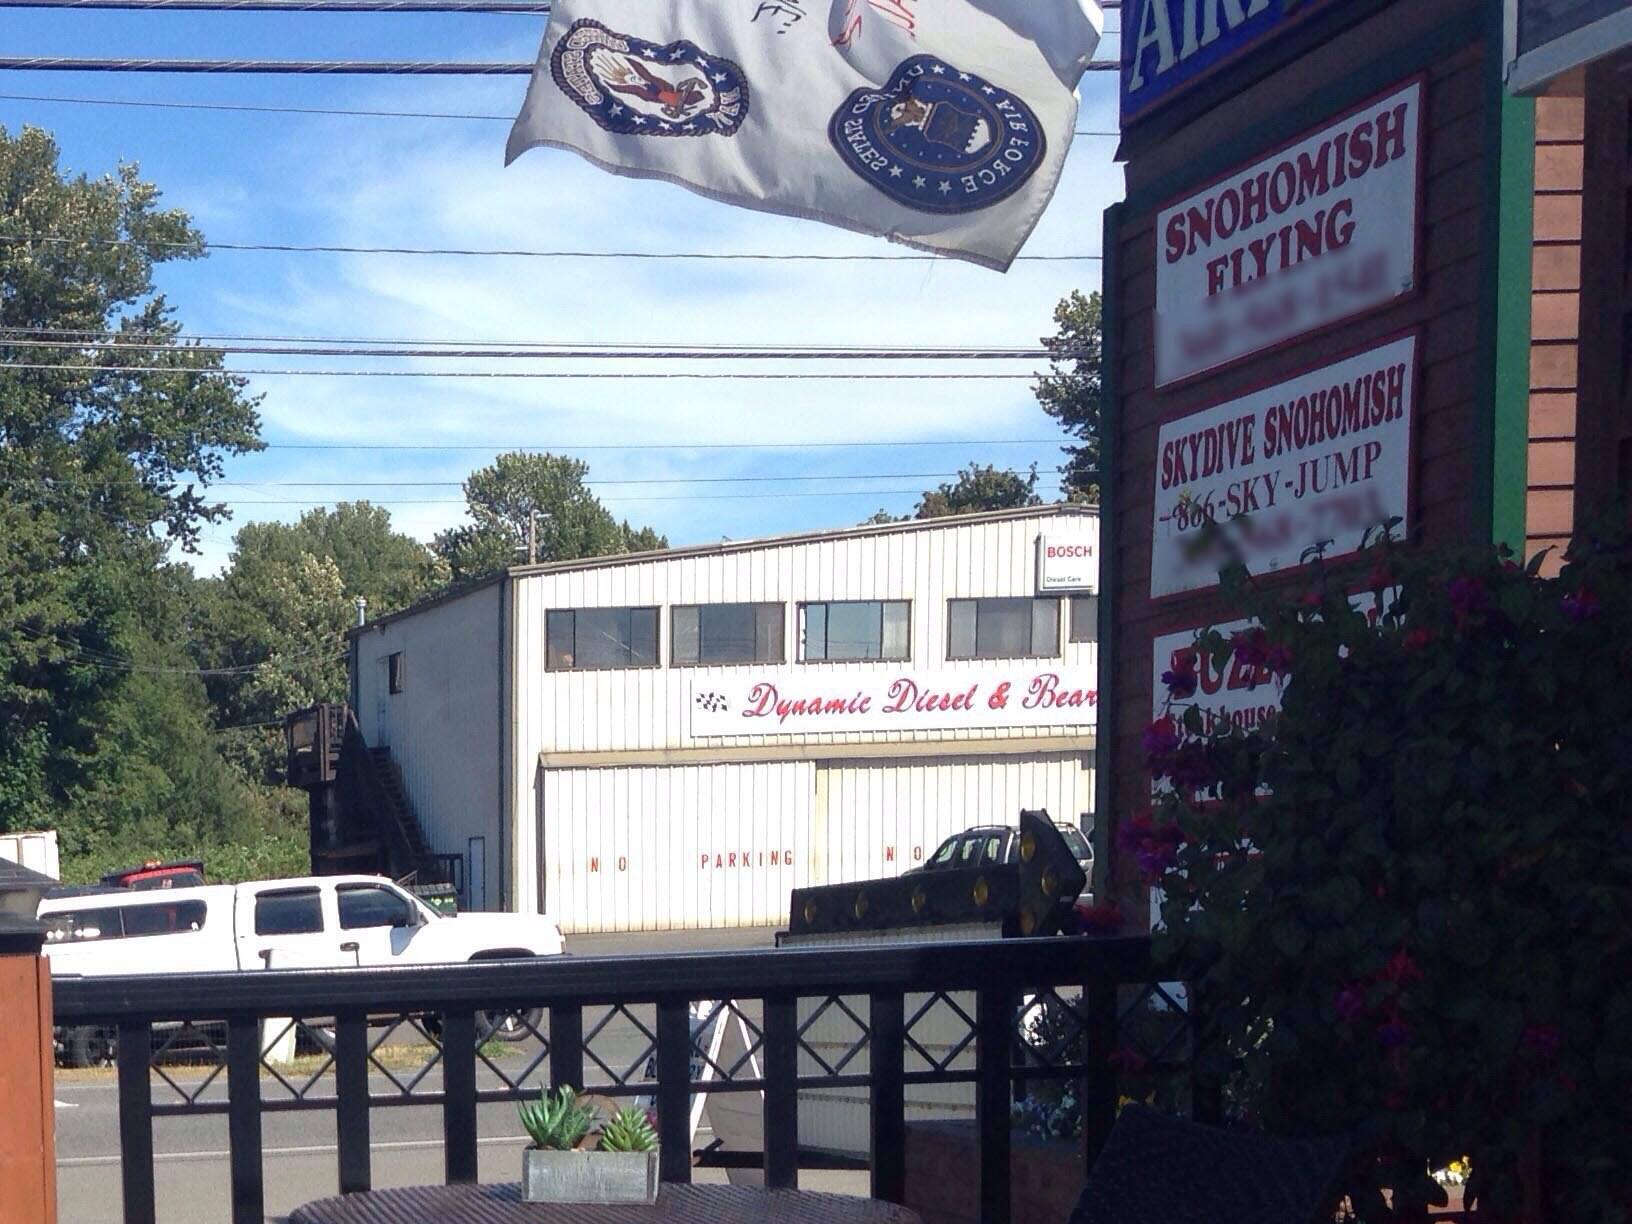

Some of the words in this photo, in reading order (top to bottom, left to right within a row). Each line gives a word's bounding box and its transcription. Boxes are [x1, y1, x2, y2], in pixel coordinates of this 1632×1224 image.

[1165, 102, 1409, 264] SNOHOMISH
[1206, 198, 1356, 297] FLYING
[1161, 413, 1256, 490] SKYDIVE
[1263, 362, 1406, 460] SNOHOMISH
[1047, 545, 1092, 558] BOSCH
[741, 682, 872, 725] Dynamic
[881, 678, 979, 713] Diesel
[987, 681, 1012, 710] &
[590, 856, 627, 872] NO
[701, 850, 793, 869] PARKING
[885, 846, 923, 861] NO
